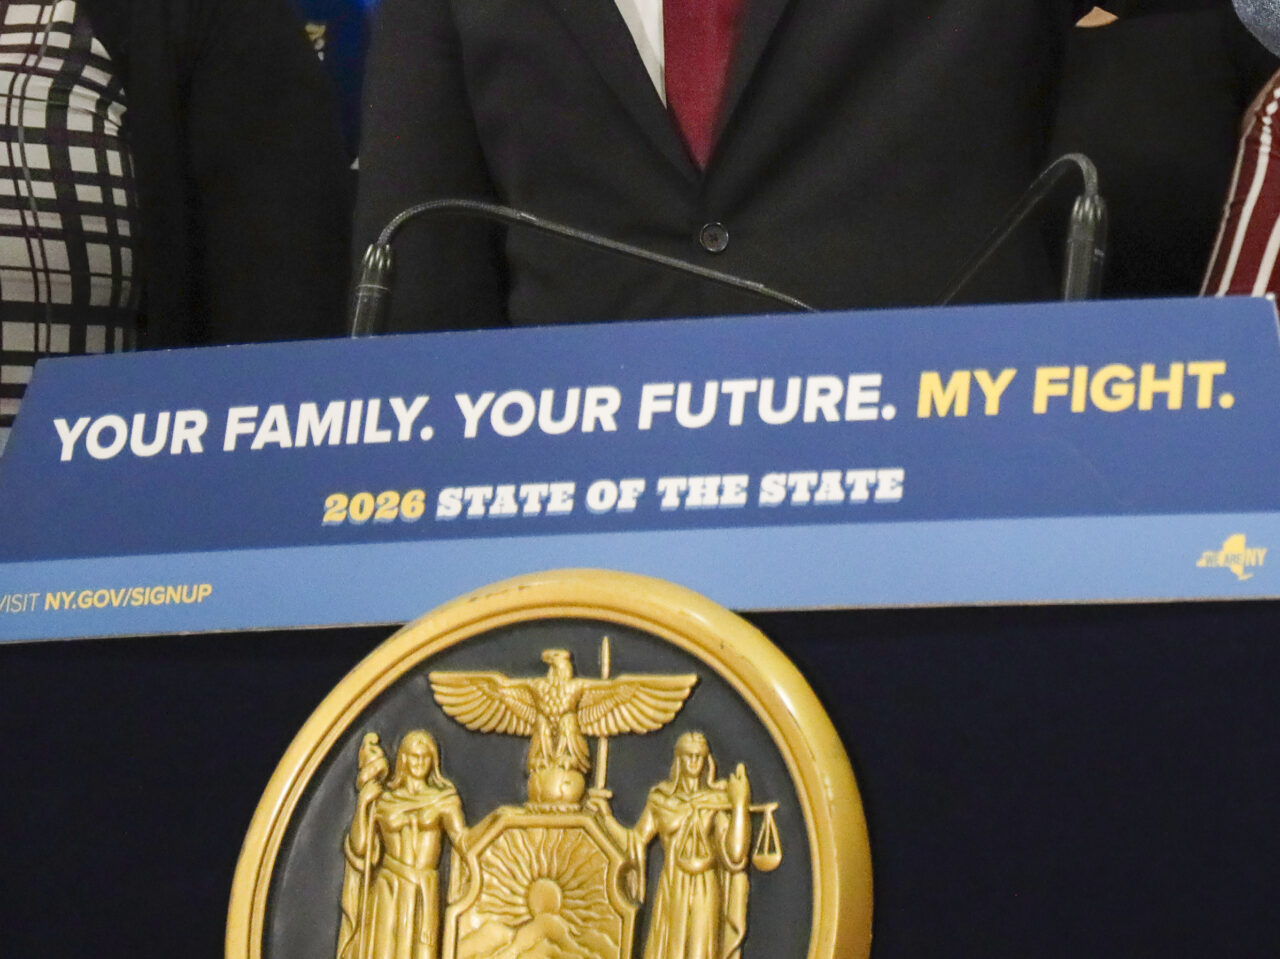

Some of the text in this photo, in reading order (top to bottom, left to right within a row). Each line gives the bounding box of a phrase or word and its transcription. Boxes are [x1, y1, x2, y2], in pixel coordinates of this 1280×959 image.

[53, 361, 1235, 462] YOUR FAMILY. YOUR FUTURE. MY FIGHT.
[321, 468, 905, 526] 2026 STATE OF THE STATE
[44, 583, 213, 611] NY.GOV/SIGNUP
